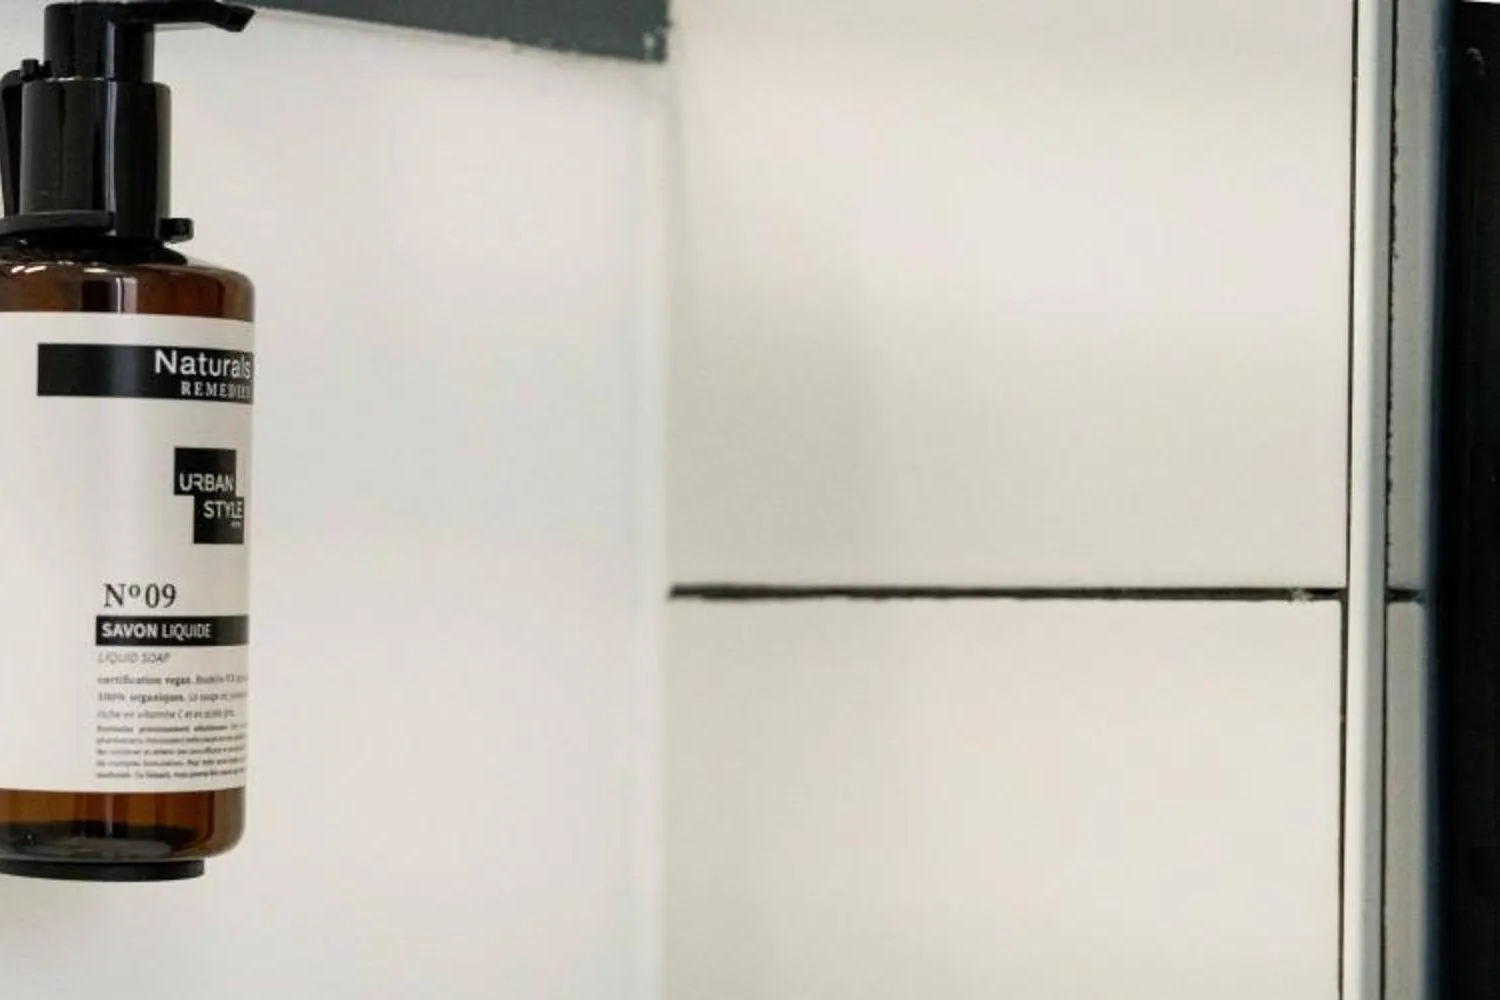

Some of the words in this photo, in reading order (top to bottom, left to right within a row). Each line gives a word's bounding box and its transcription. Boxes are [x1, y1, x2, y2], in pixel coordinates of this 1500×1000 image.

[155, 349, 252, 379] Naturals
[179, 473, 233, 492] URBAN
[203, 501, 243, 519] STYLE
[102, 623, 158, 638] SAVON
[161, 623, 212, 640] LIQUIDE
[97, 652, 138, 664] LIQUID
[141, 652, 170, 664] SOAP
